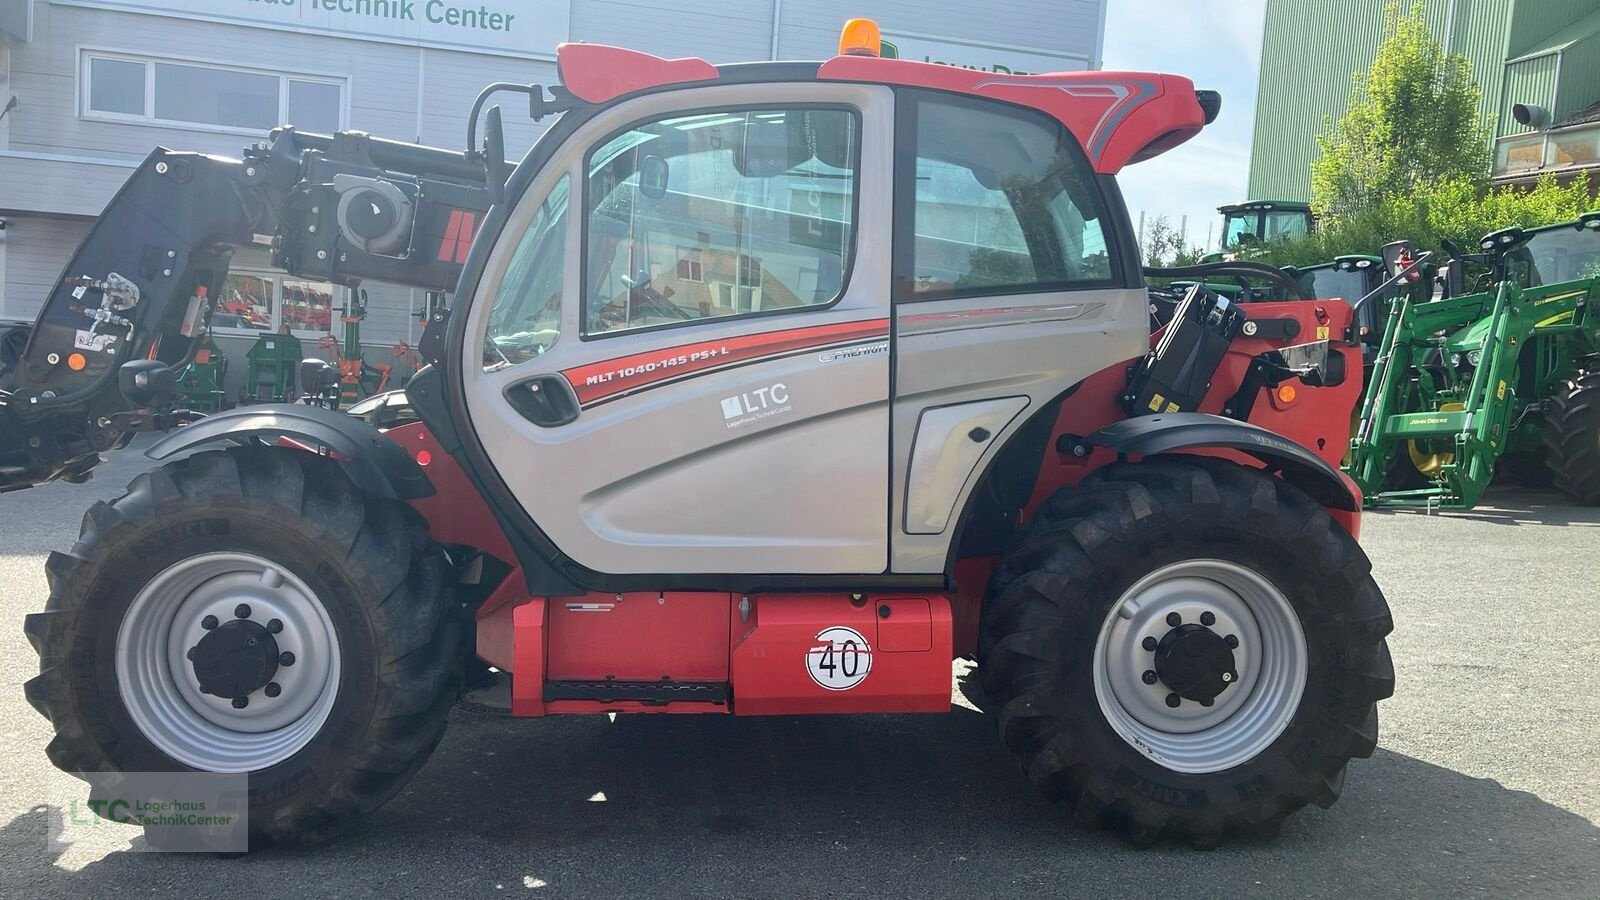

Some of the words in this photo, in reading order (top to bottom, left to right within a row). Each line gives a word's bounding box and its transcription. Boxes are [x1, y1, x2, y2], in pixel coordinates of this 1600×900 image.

[426, 0, 515, 32] Center
[586, 371, 614, 386] MLT
[617, 356, 687, 378] 1040-145
[690, 349, 718, 362] PS+
[721, 346, 730, 355] L
[834, 344, 888, 360] PREMIUM
[742, 383, 789, 413] LTC
[818, 639, 859, 679] 40
